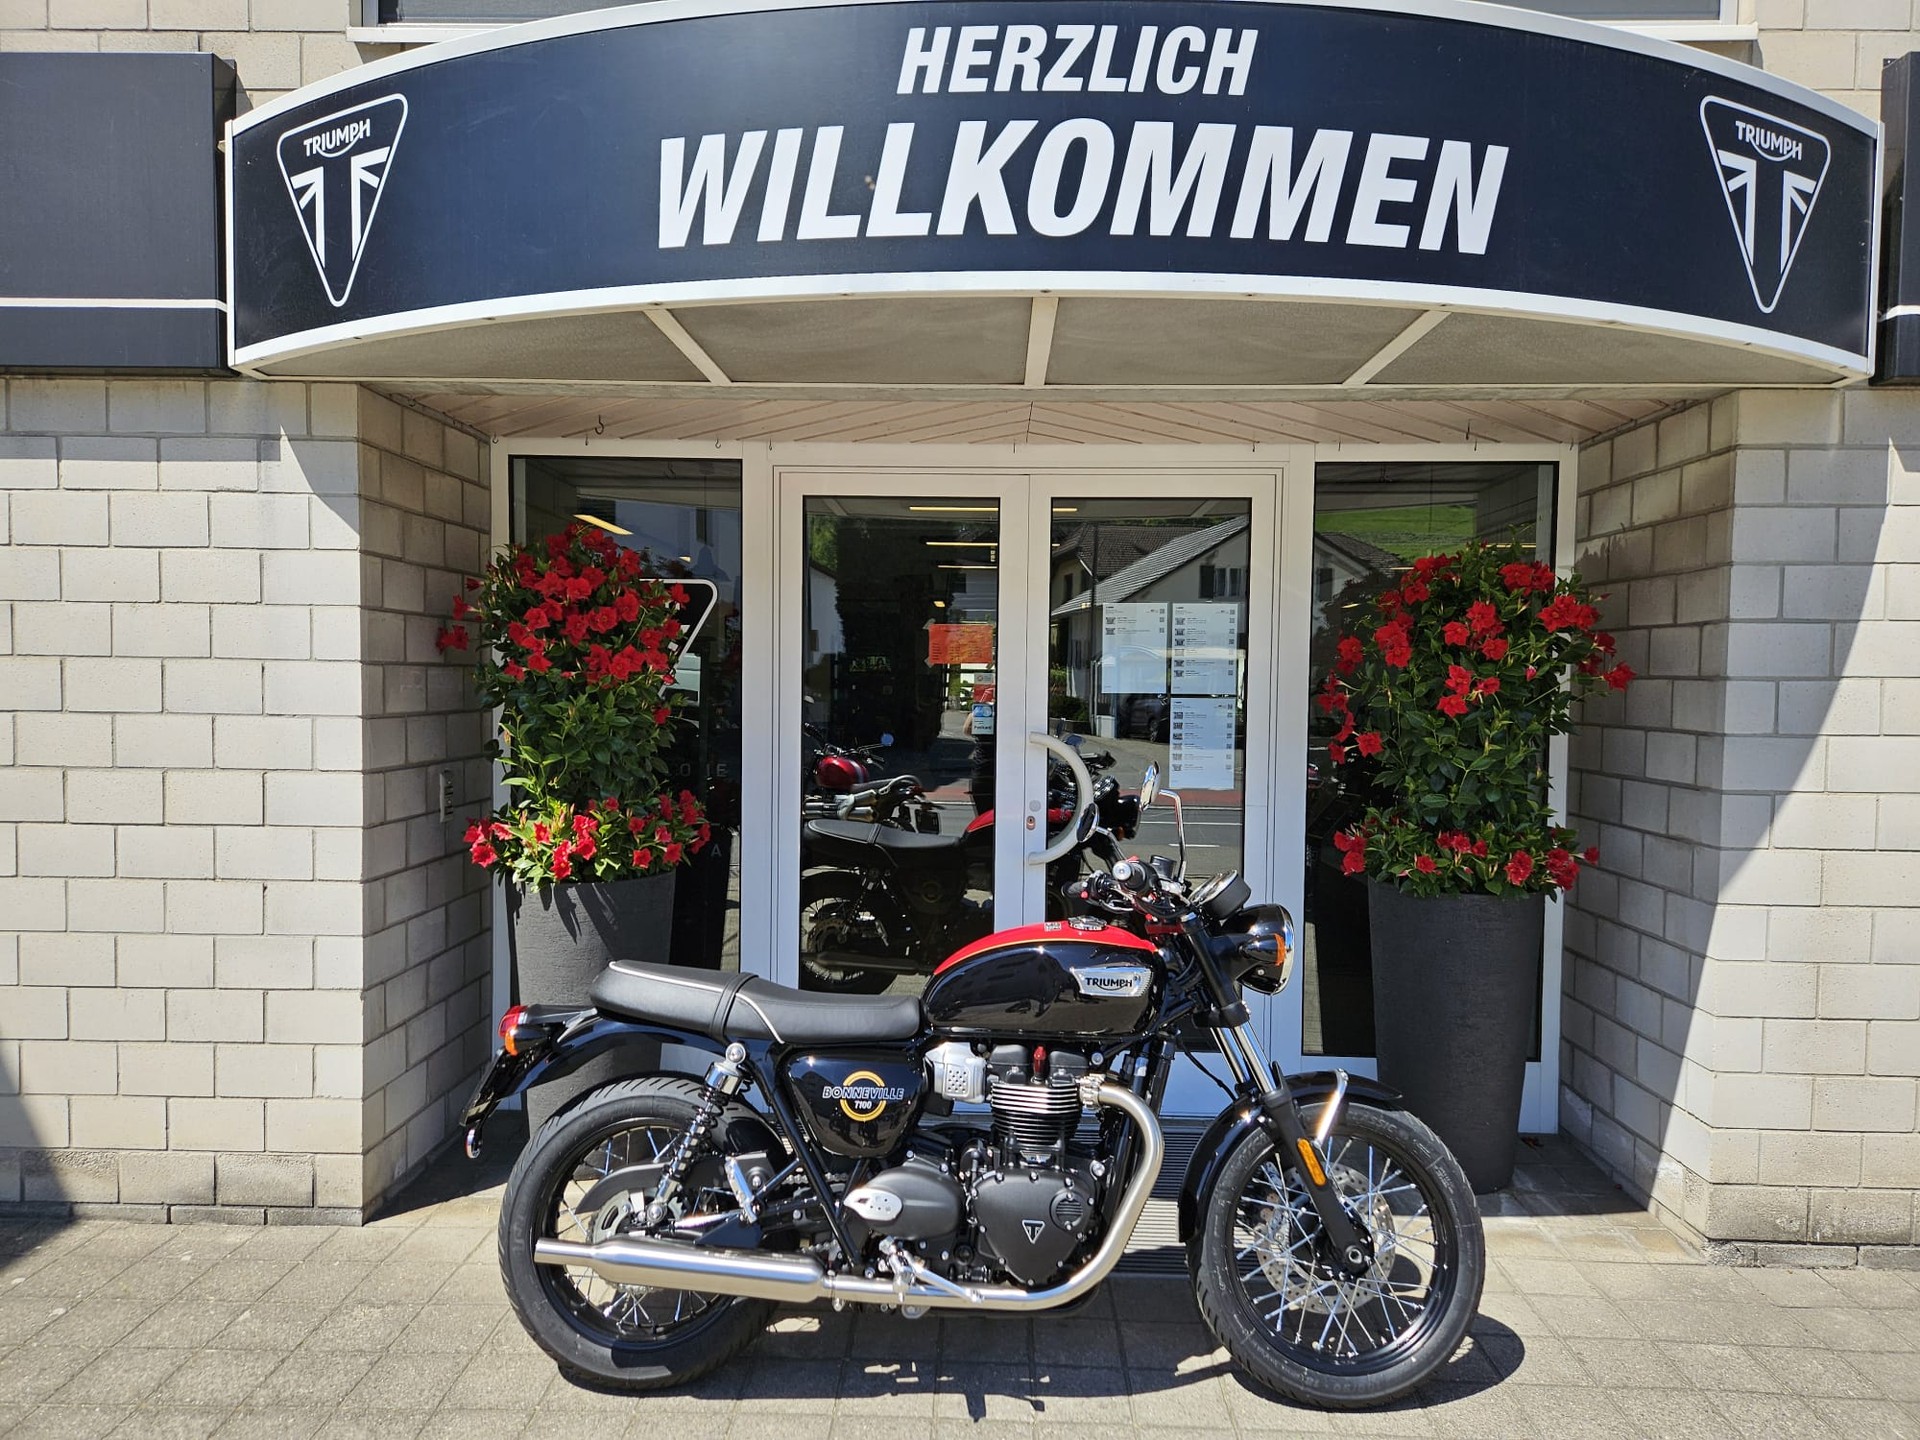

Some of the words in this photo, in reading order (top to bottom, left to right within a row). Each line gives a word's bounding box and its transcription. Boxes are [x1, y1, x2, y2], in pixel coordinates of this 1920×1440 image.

[896, 24, 1259, 96] HERZLICH
[303, 118, 371, 158] TRIUMPH
[1735, 120, 1803, 162] TRIUMPH
[658, 117, 1509, 256] WILLKOMMEN
[1085, 977, 1133, 991] TRIUMPH
[822, 1086, 905, 1100] BONNEVILLE
[854, 1100, 873, 1110] T100
